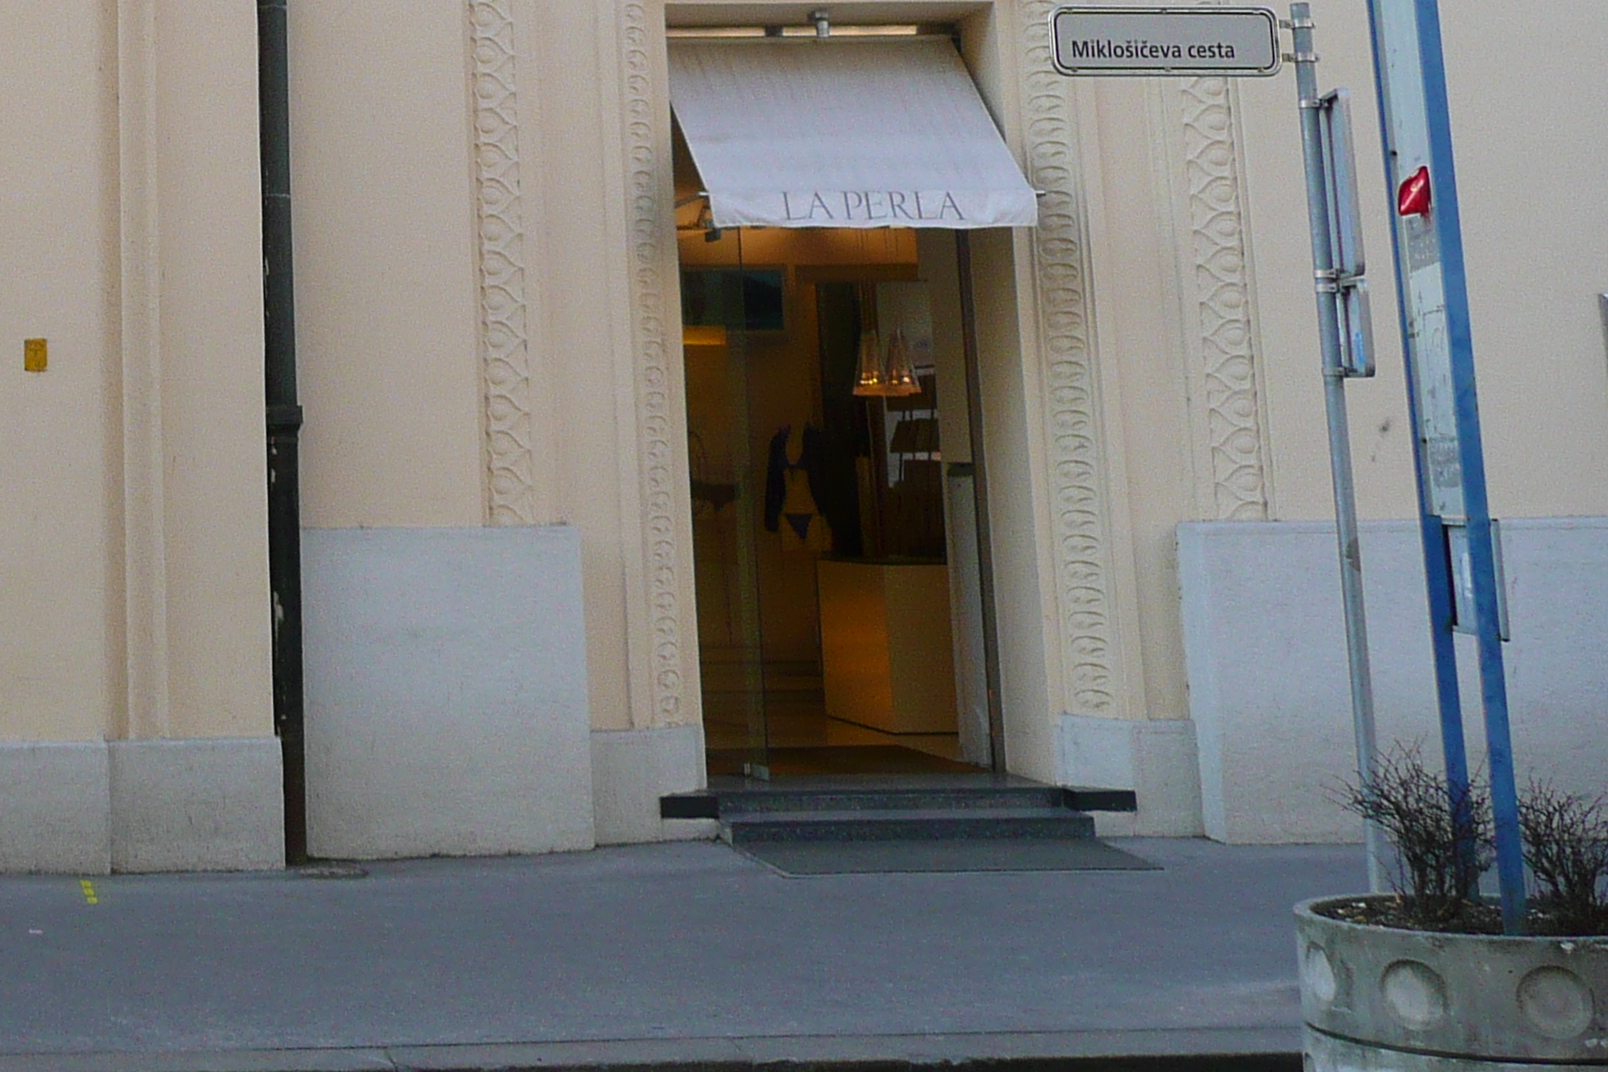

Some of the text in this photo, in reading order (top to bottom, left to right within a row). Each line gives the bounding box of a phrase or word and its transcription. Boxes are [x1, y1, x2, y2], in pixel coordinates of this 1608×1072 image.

[1071, 39, 1236, 59] Miklošičeva cesta
[781, 190, 967, 221] LA PERLA
